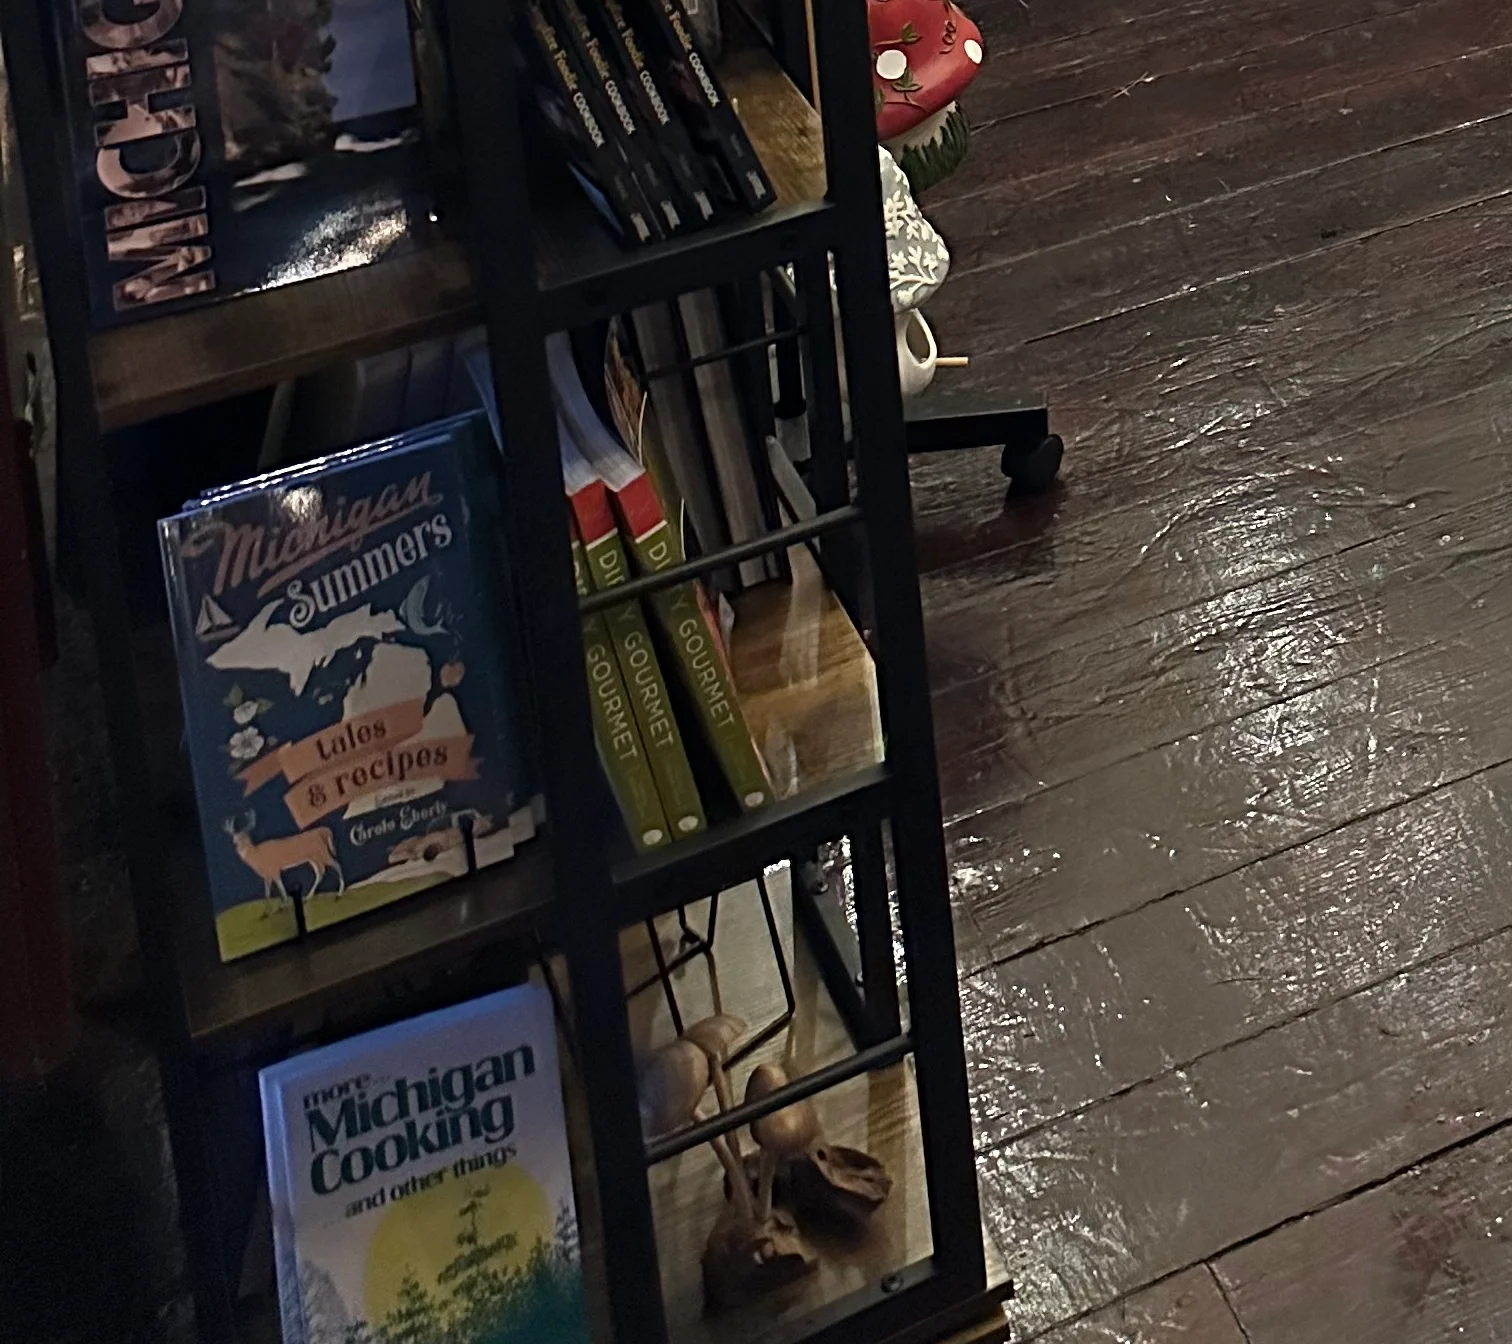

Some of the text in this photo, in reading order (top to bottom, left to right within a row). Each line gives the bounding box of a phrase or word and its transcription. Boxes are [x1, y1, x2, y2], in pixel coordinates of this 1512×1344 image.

[605, 79, 637, 136] COOKBOOK
[639, 70, 671, 126] COOKBOOK
[689, 52, 720, 108] COOKBOOK
[573, 91, 605, 148] COOKBOOK
[181, 469, 443, 596] Michigan
[285, 510, 454, 629] Summers
[586, 642, 638, 760] GOURMET
[624, 630, 675, 749] GOURMET
[678, 617, 735, 730] GOURMET
[314, 716, 390, 762] tales
[307, 745, 451, 808] & recipes
[398, 798, 451, 838] Eberly
[303, 1071, 373, 1111] more
[304, 1041, 538, 1155] Michigan
[310, 1090, 518, 1200] Cooking
[343, 1140, 519, 1222] and other things
